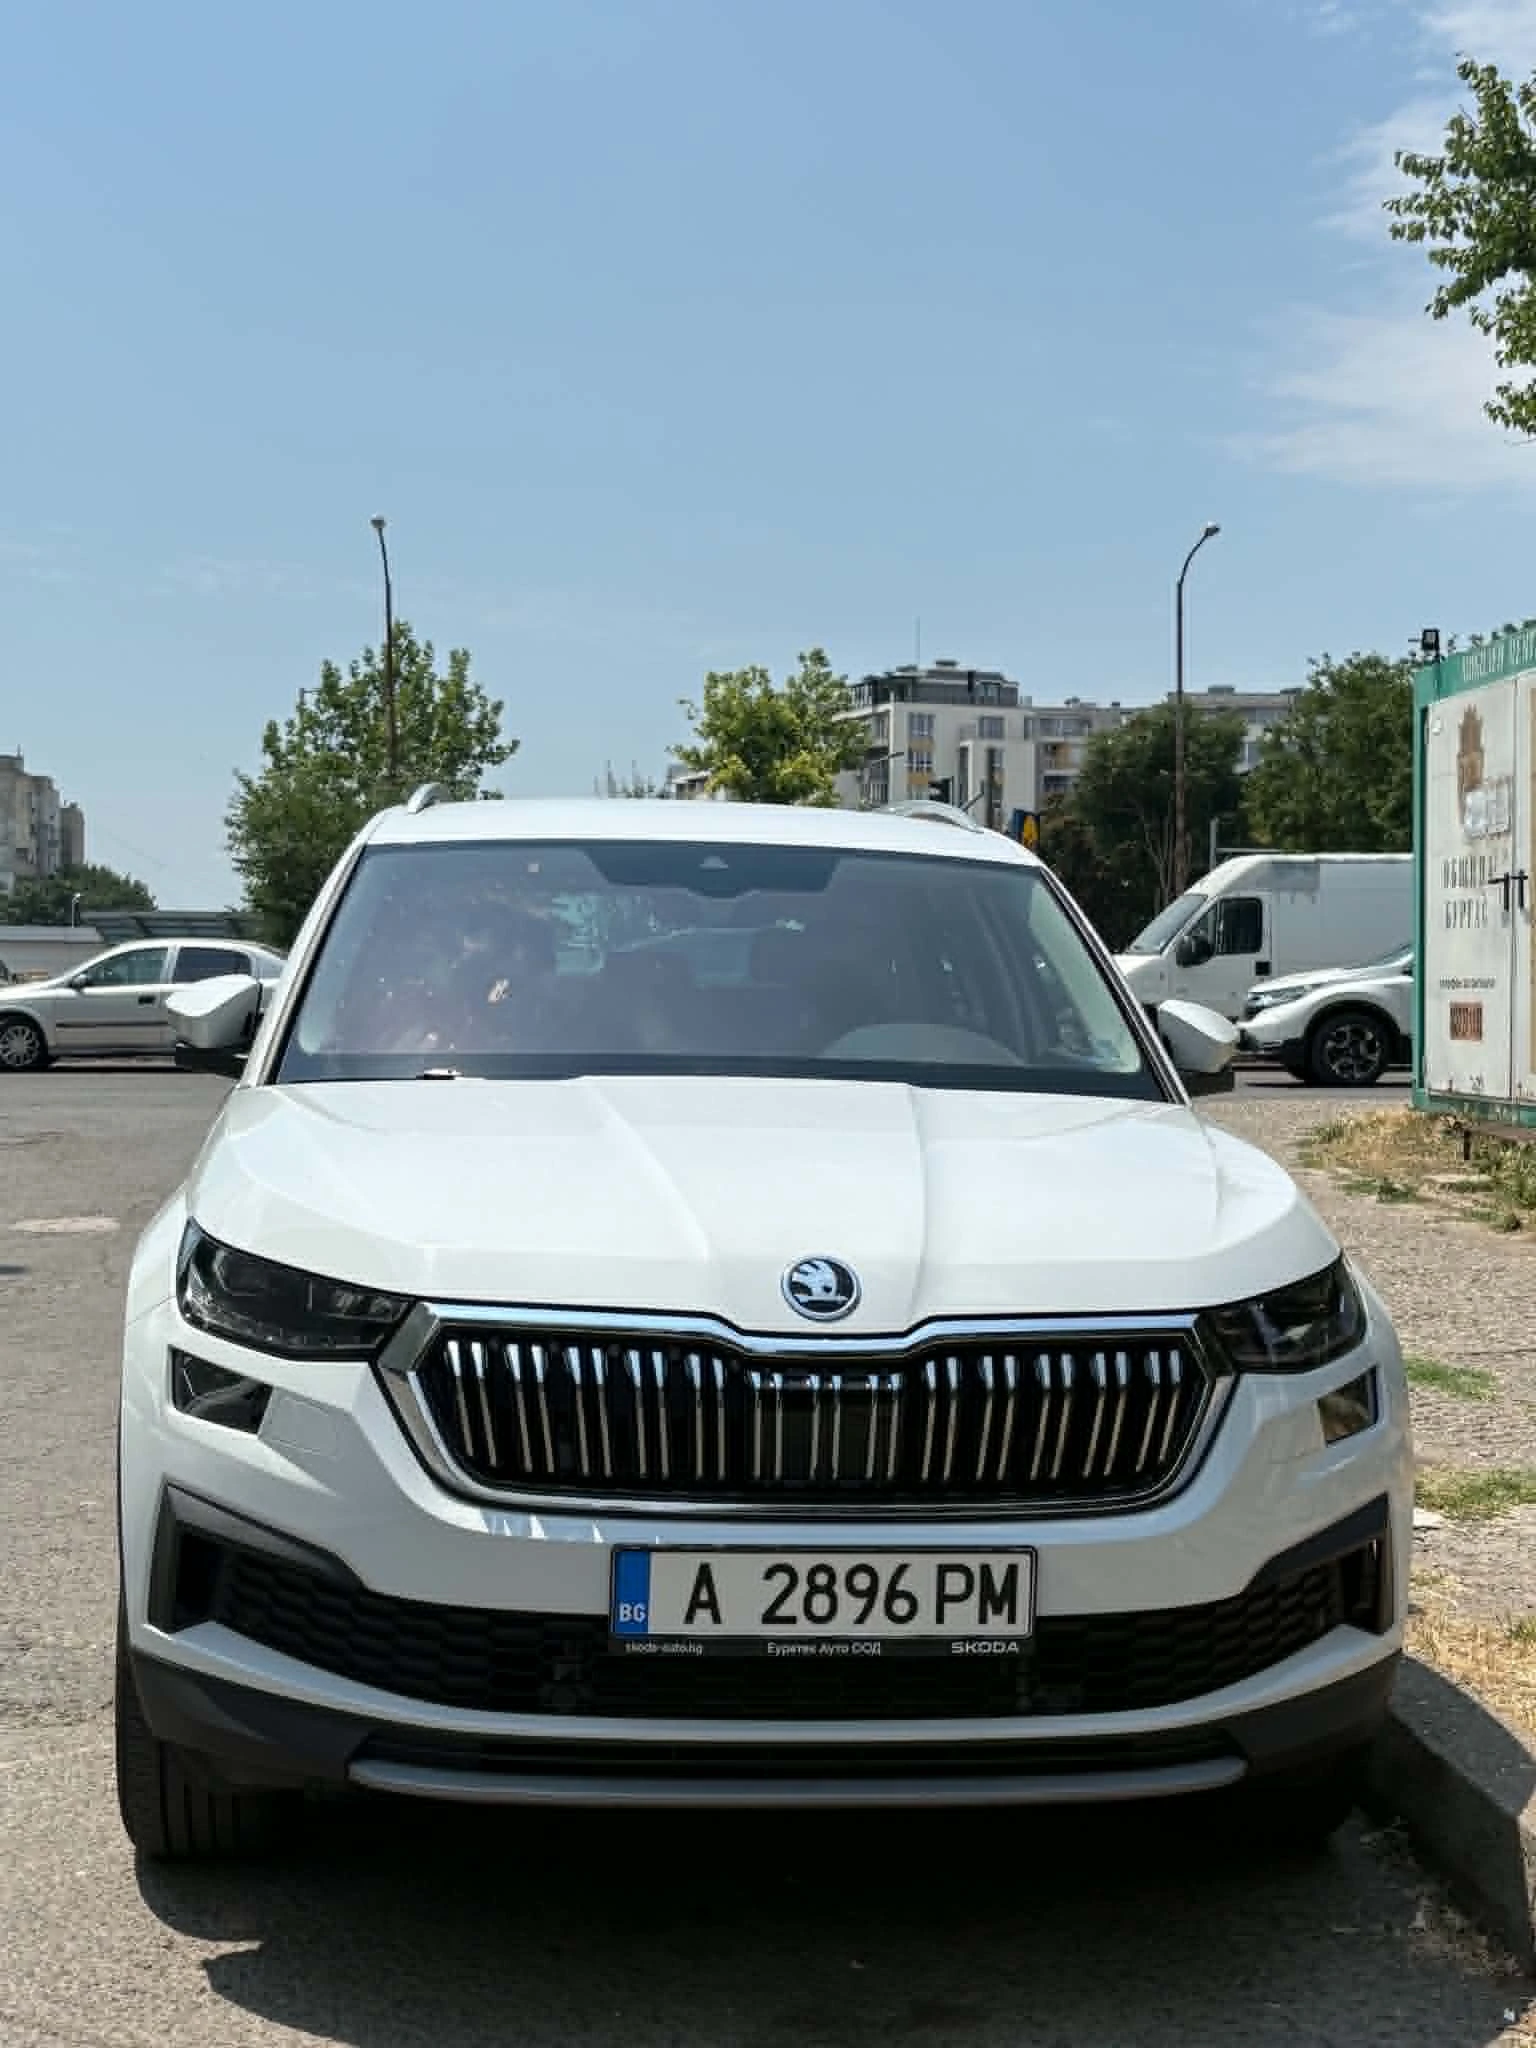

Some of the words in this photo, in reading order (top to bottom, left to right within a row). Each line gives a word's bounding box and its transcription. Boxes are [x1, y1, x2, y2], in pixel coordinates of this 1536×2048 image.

[619, 1602, 646, 1623] BG
[683, 1562, 722, 1625] A
[761, 1562, 919, 1625] 2896
[935, 1562, 1019, 1625] PM
